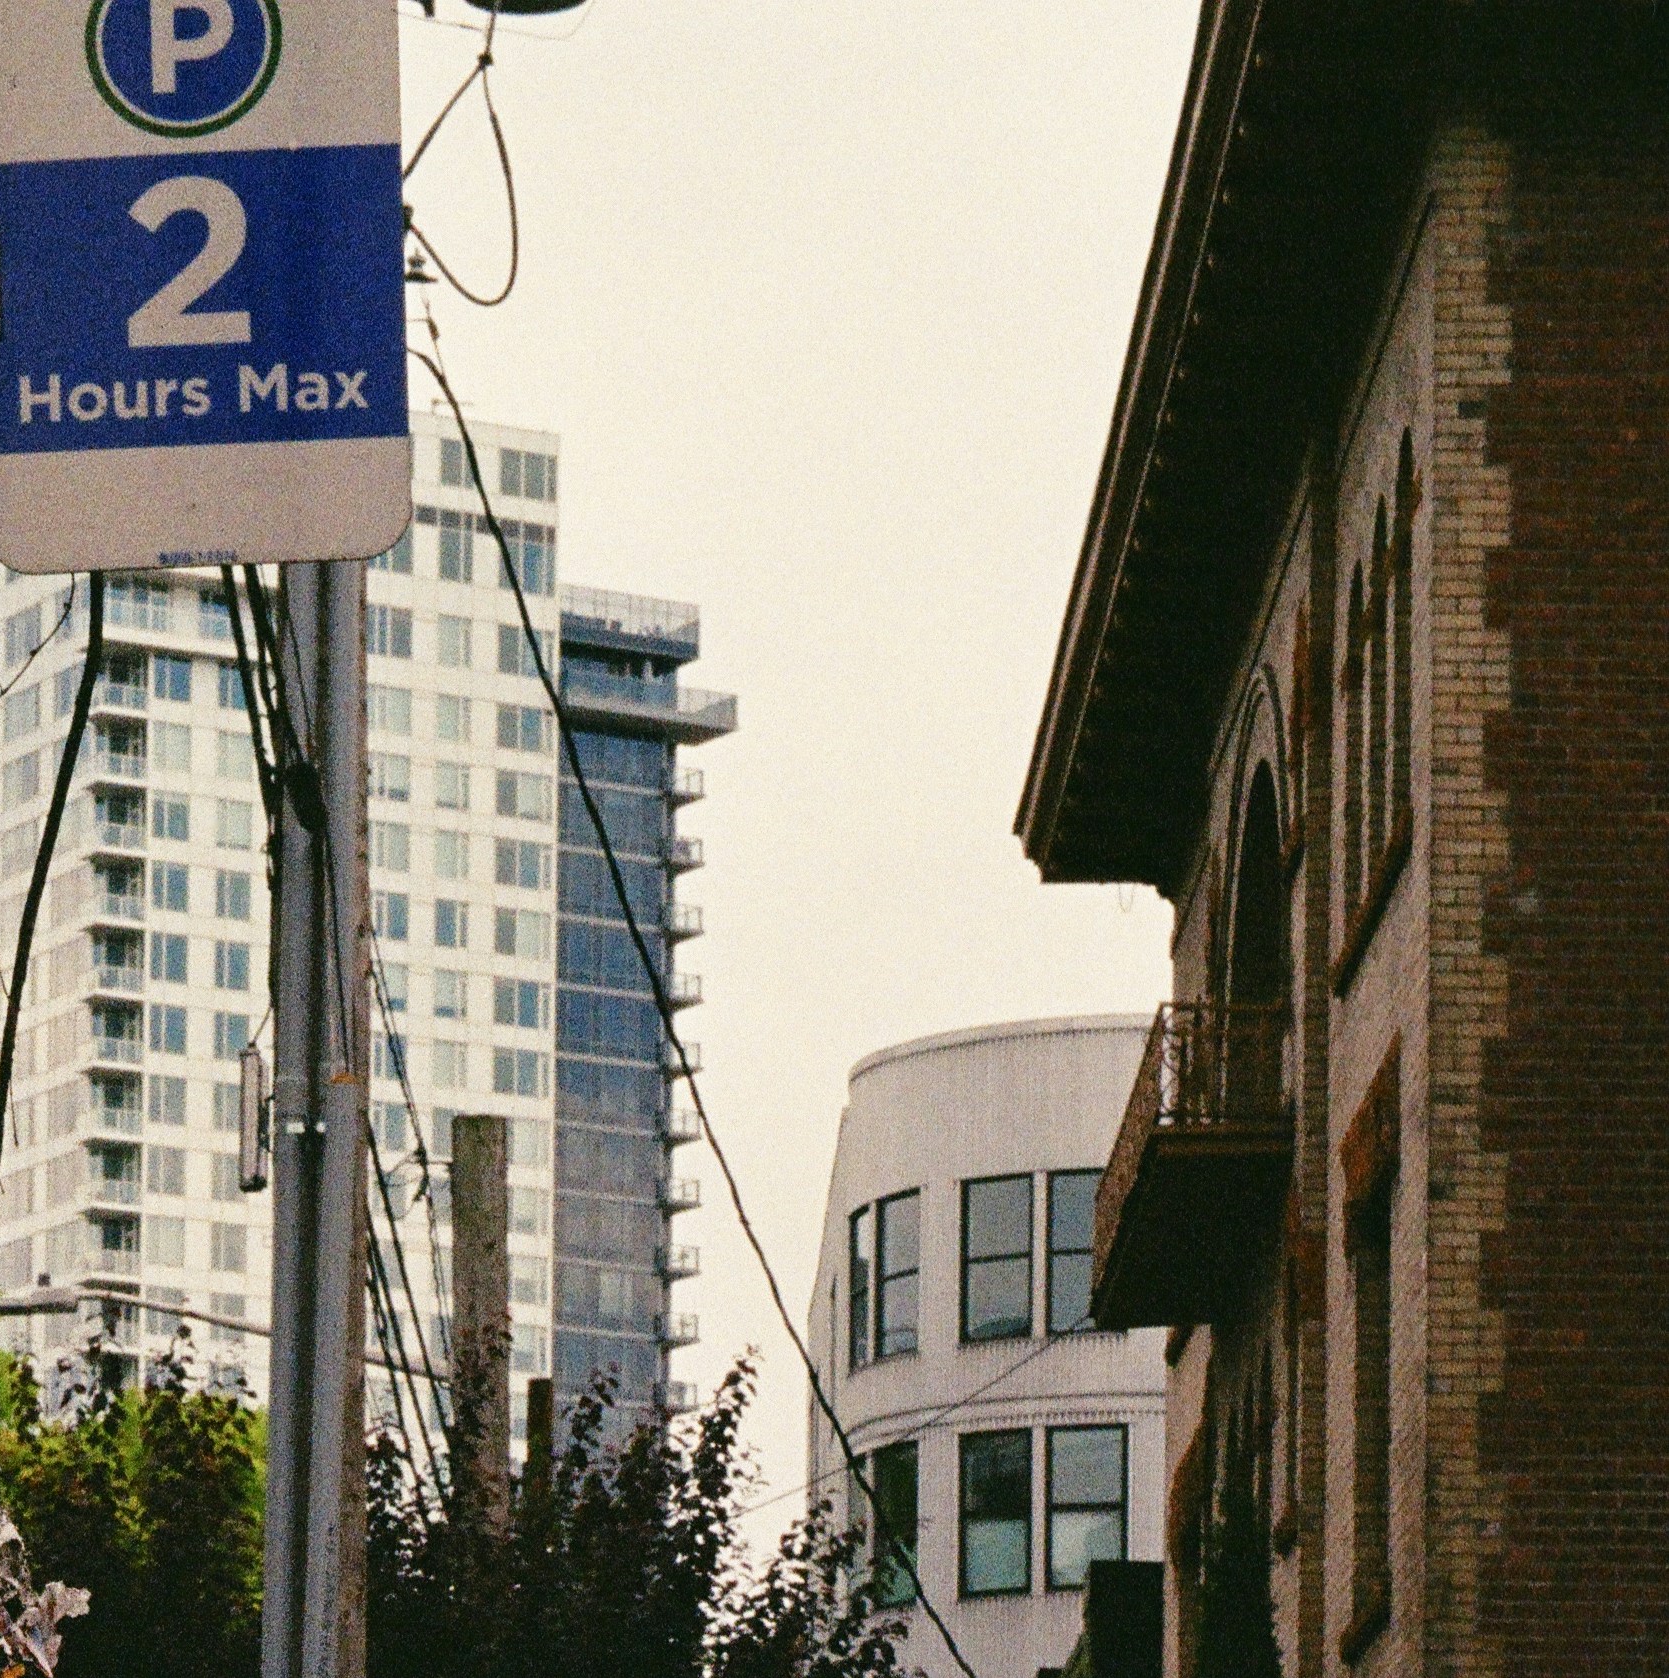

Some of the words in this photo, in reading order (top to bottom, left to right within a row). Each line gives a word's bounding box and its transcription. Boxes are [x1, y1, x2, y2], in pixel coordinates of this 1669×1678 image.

[128, 175, 252, 349] 2
[18, 372, 212, 424] Hours
[237, 362, 370, 414] Max
